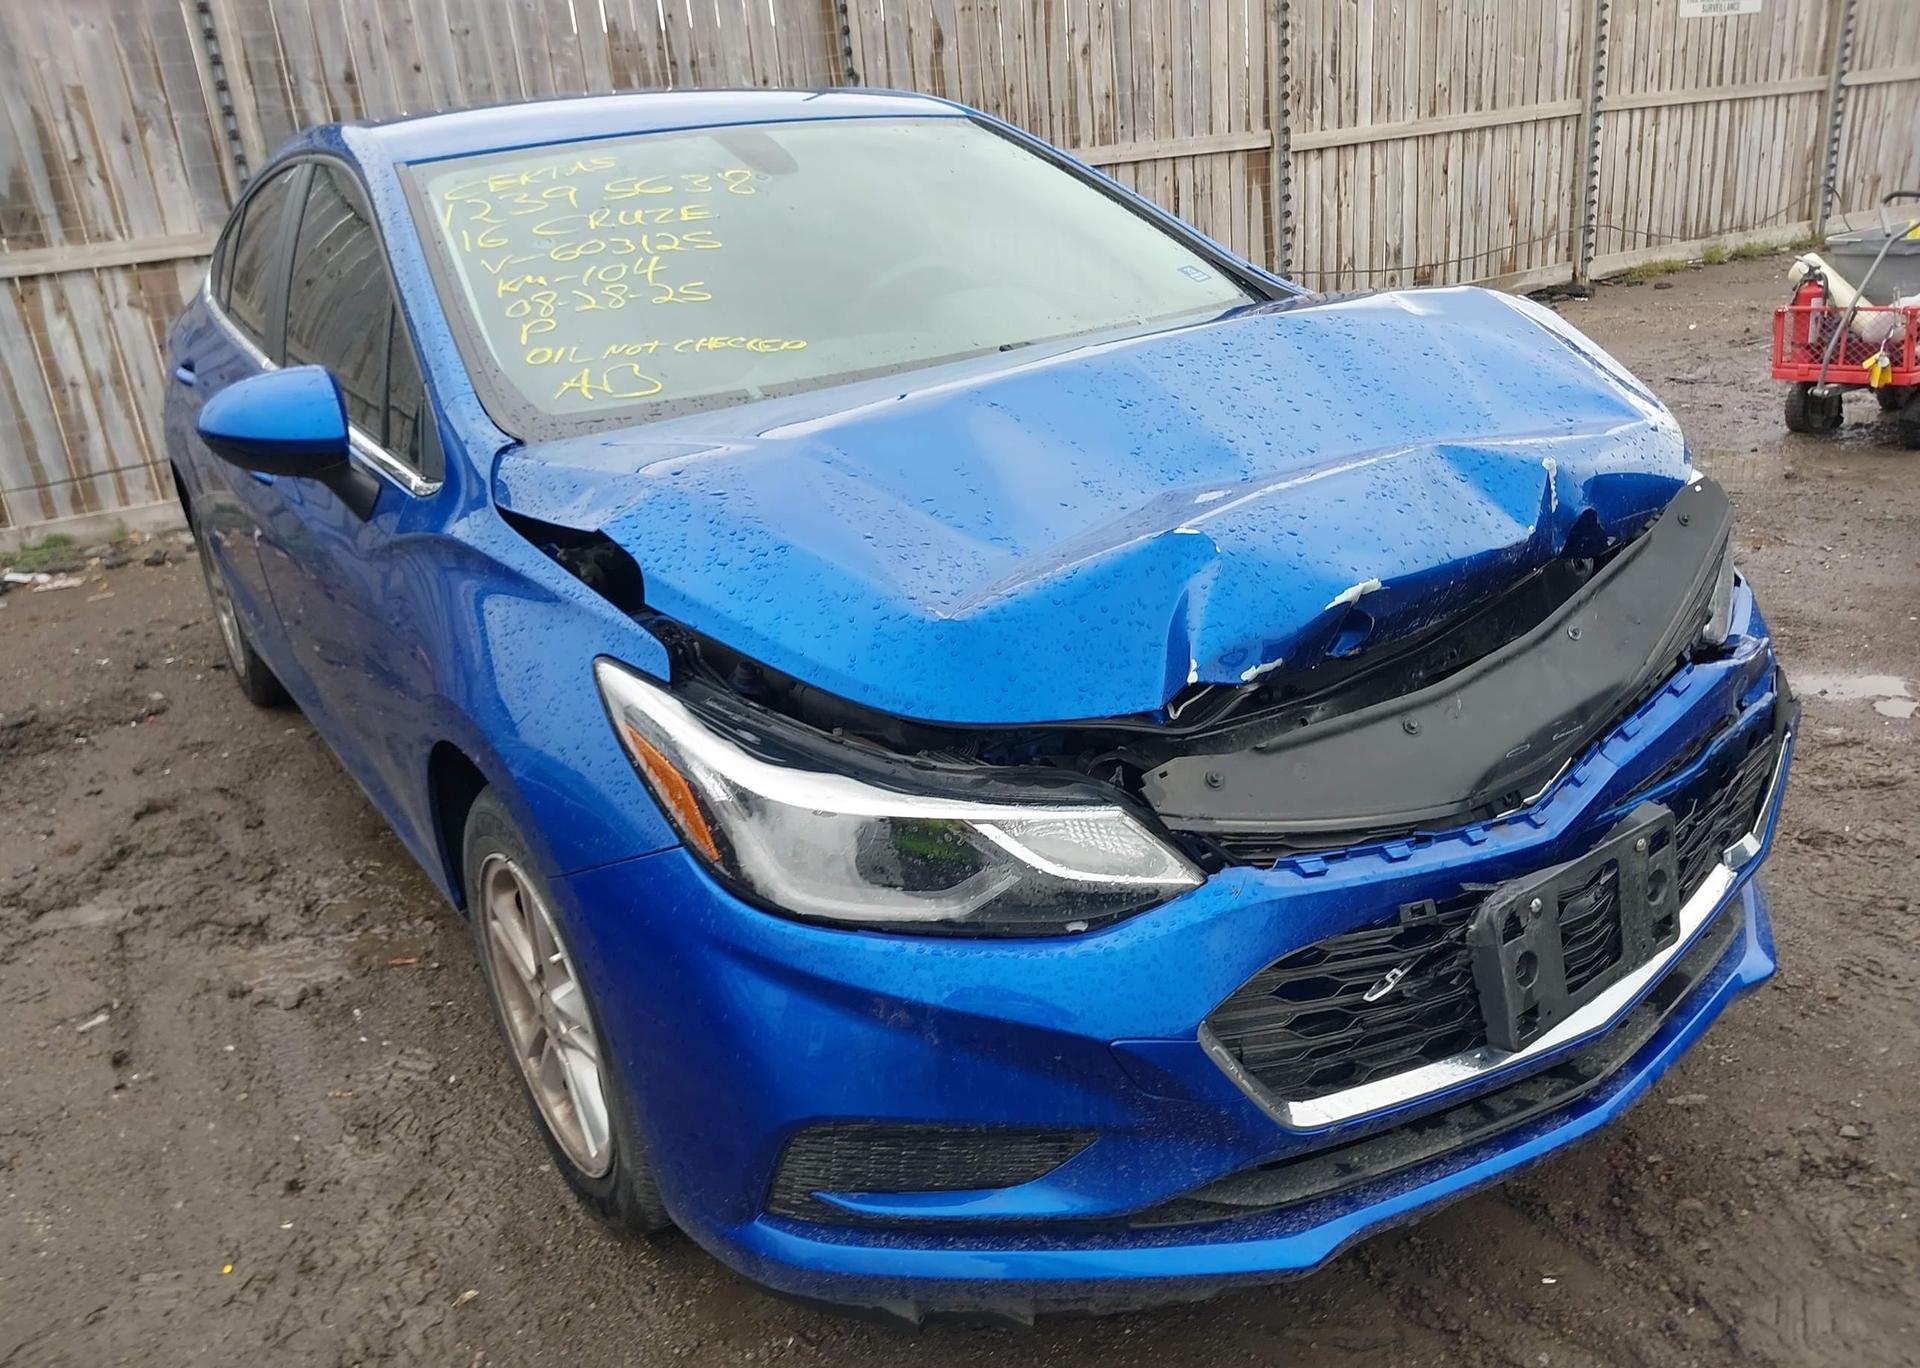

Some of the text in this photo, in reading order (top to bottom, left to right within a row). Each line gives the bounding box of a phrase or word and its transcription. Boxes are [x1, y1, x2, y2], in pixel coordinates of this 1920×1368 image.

[462, 204, 719, 253] 16 CRUZE
[505, 282, 713, 318] 08-28-25
[520, 318, 557, 346] P
[525, 336, 808, 365] OIL NOT CHECKED
